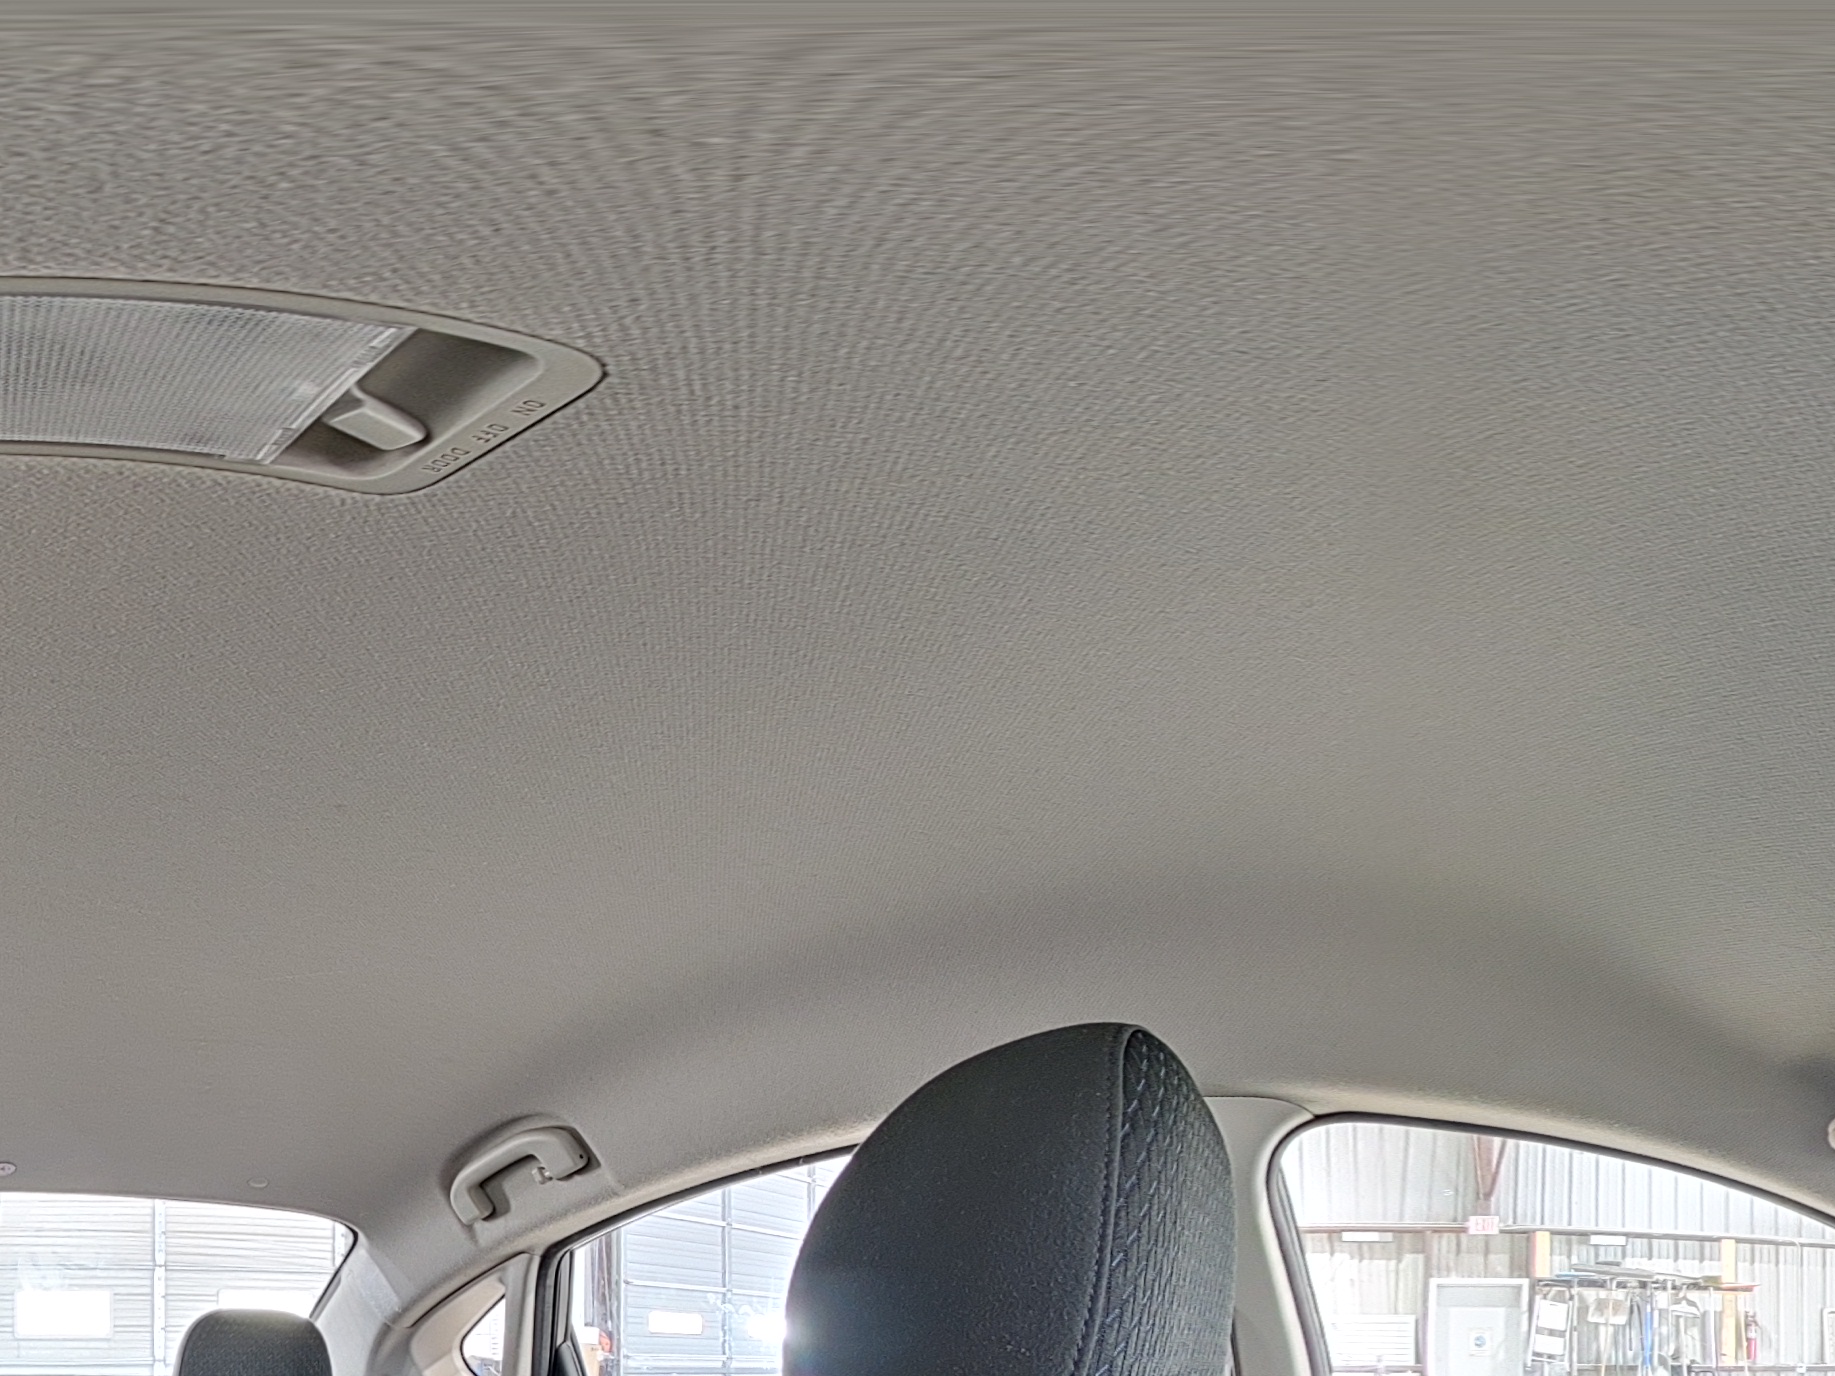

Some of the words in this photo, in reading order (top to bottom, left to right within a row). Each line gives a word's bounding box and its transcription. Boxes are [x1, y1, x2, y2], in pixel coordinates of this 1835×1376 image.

[510, 399, 546, 417] ON
[471, 423, 510, 443] OFF
[421, 447, 471, 473] DOOR
